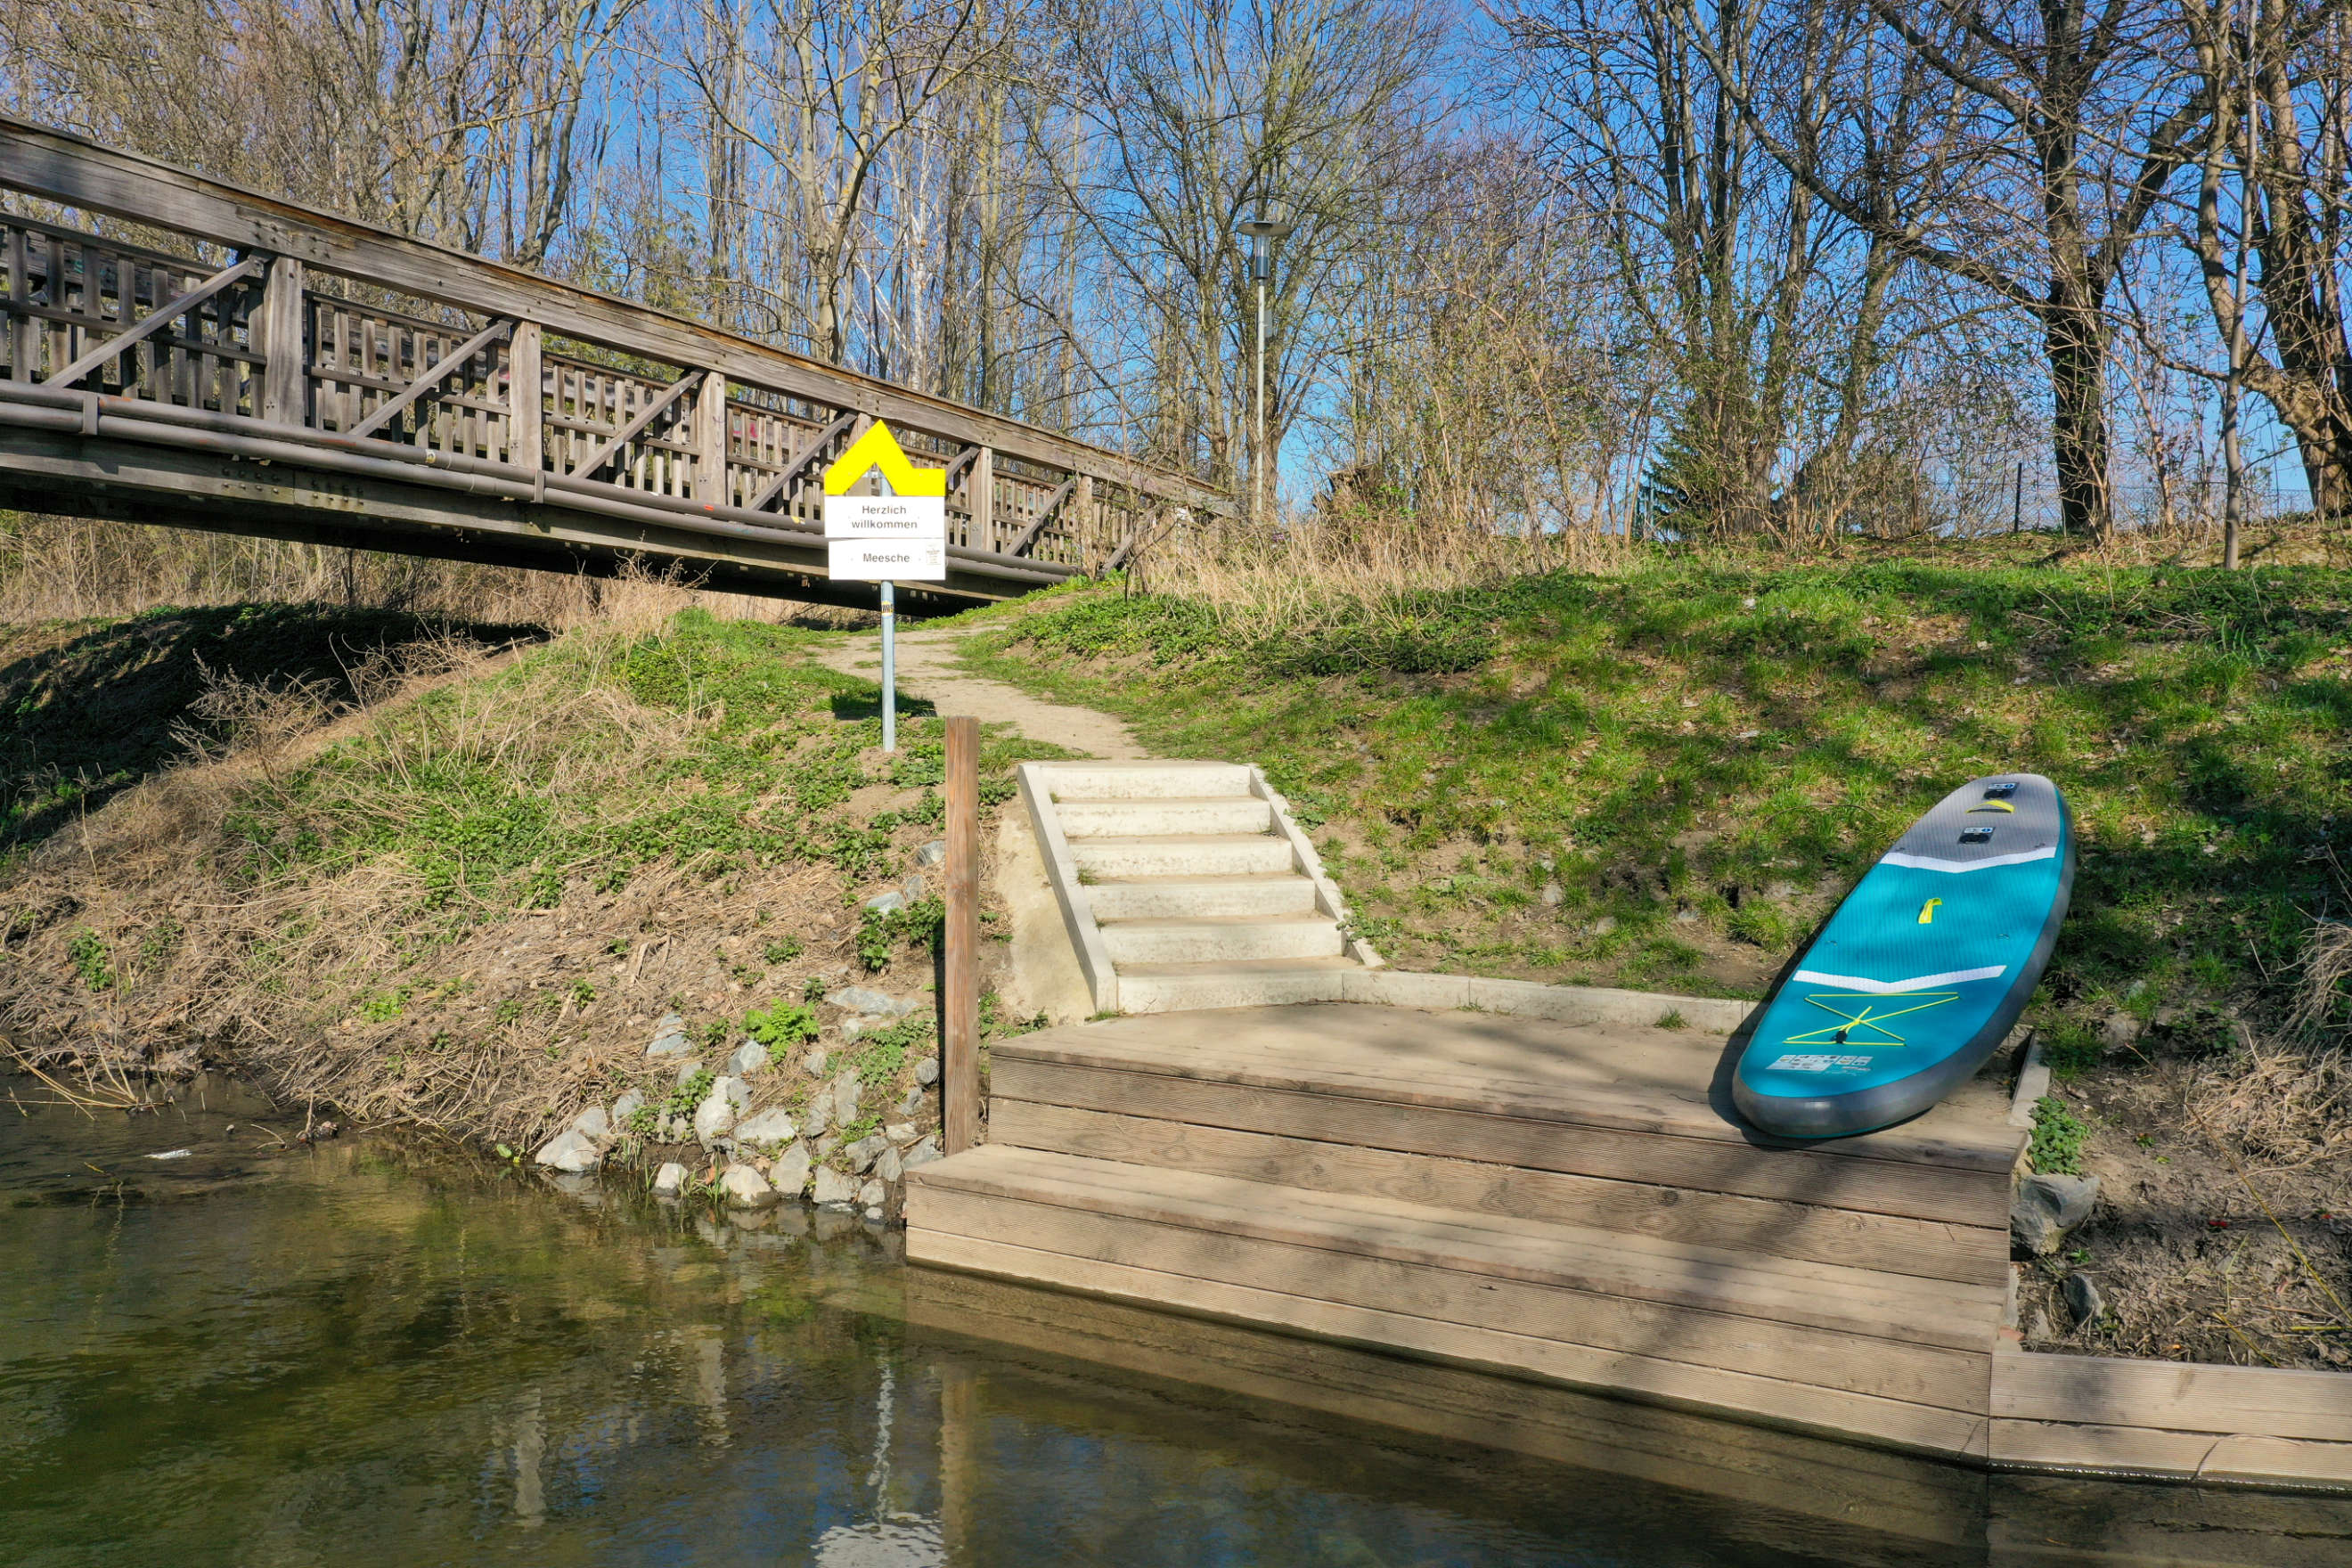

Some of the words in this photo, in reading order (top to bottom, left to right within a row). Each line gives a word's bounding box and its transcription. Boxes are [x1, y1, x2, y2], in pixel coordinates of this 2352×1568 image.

[862, 505, 907, 515] Herzlich
[851, 519, 918, 529] willkommen
[862, 552, 911, 563] Meesche
